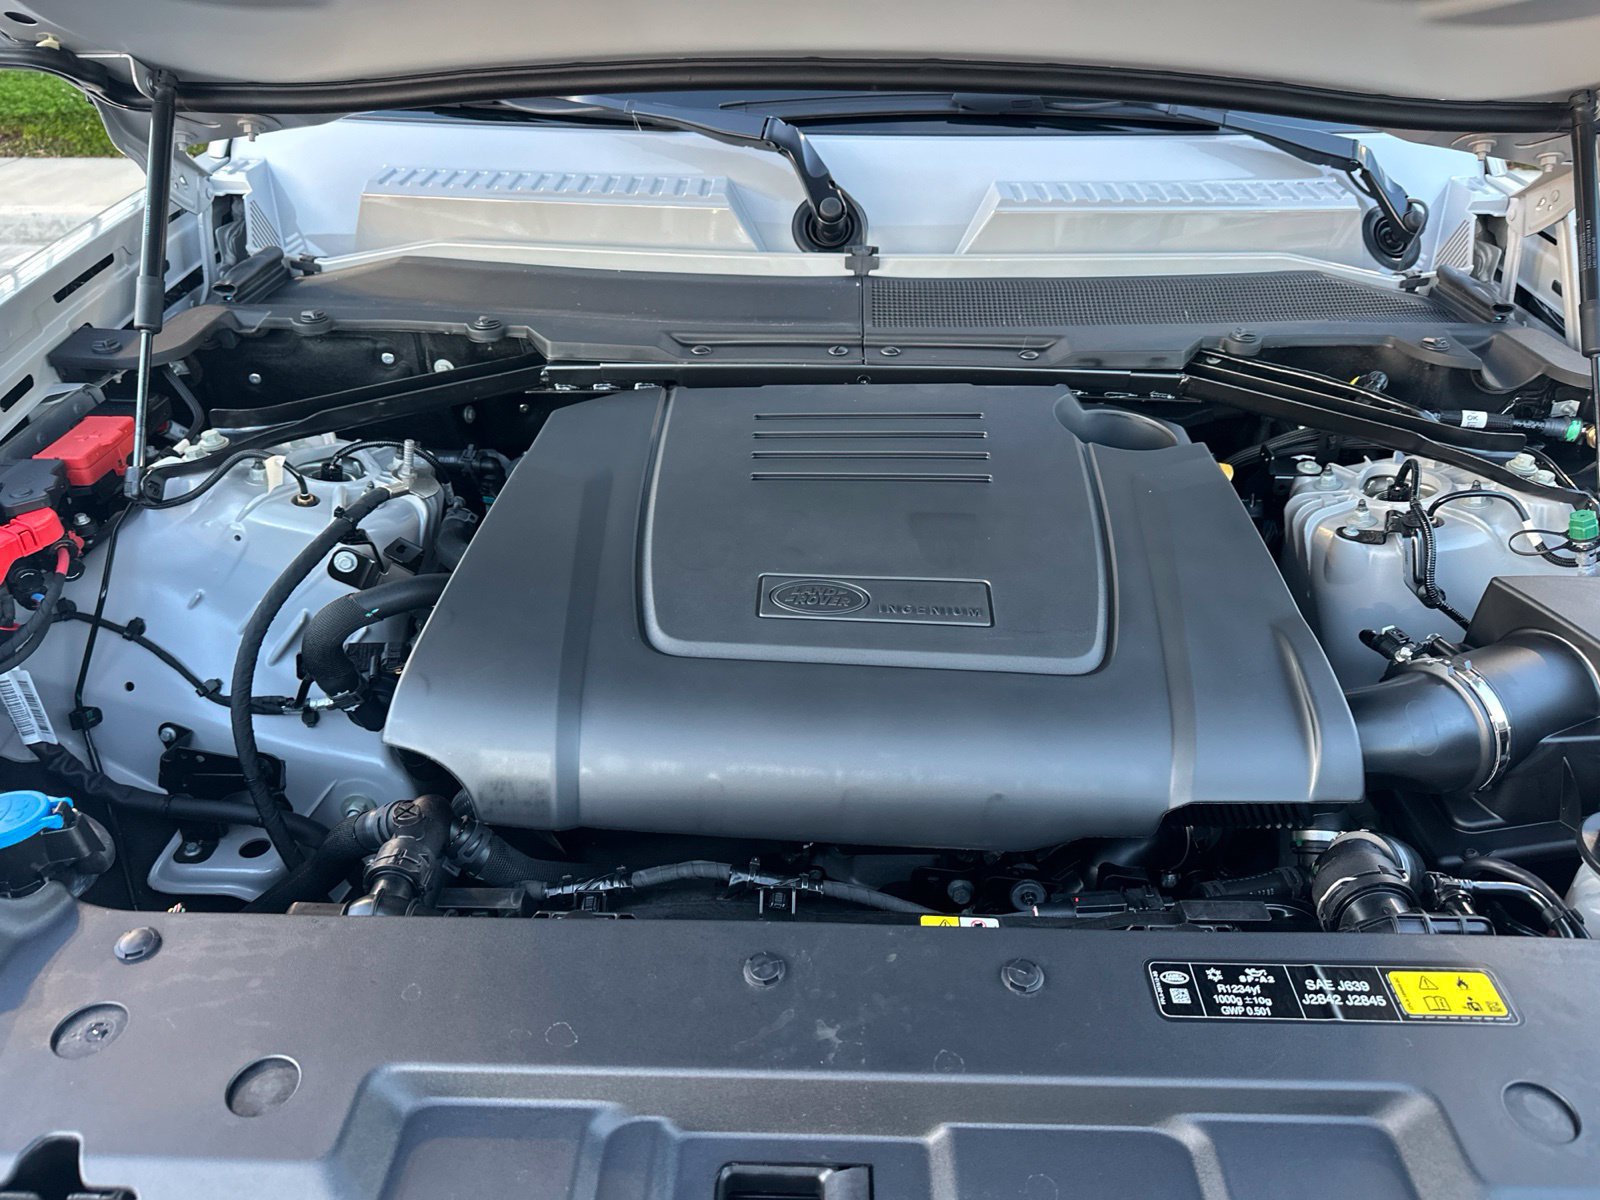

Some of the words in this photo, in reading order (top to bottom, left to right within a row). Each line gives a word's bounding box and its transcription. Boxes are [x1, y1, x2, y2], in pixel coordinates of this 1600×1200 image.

[791, 586, 834, 596] LAND
[795, 596, 849, 607] ROVER
[878, 604, 982, 617] INGENIUM
[1217, 984, 1261, 995] R1234yf
[1305, 979, 1335, 991] SAE
[1338, 980, 1370, 992] J639
[1213, 994, 1243, 1005] 1000g
[1302, 994, 1343, 1006] J2842
[1345, 995, 1387, 1007] J2845
[1221, 1006, 1245, 1015] GWP
[1246, 1006, 1271, 1016] 0.501
